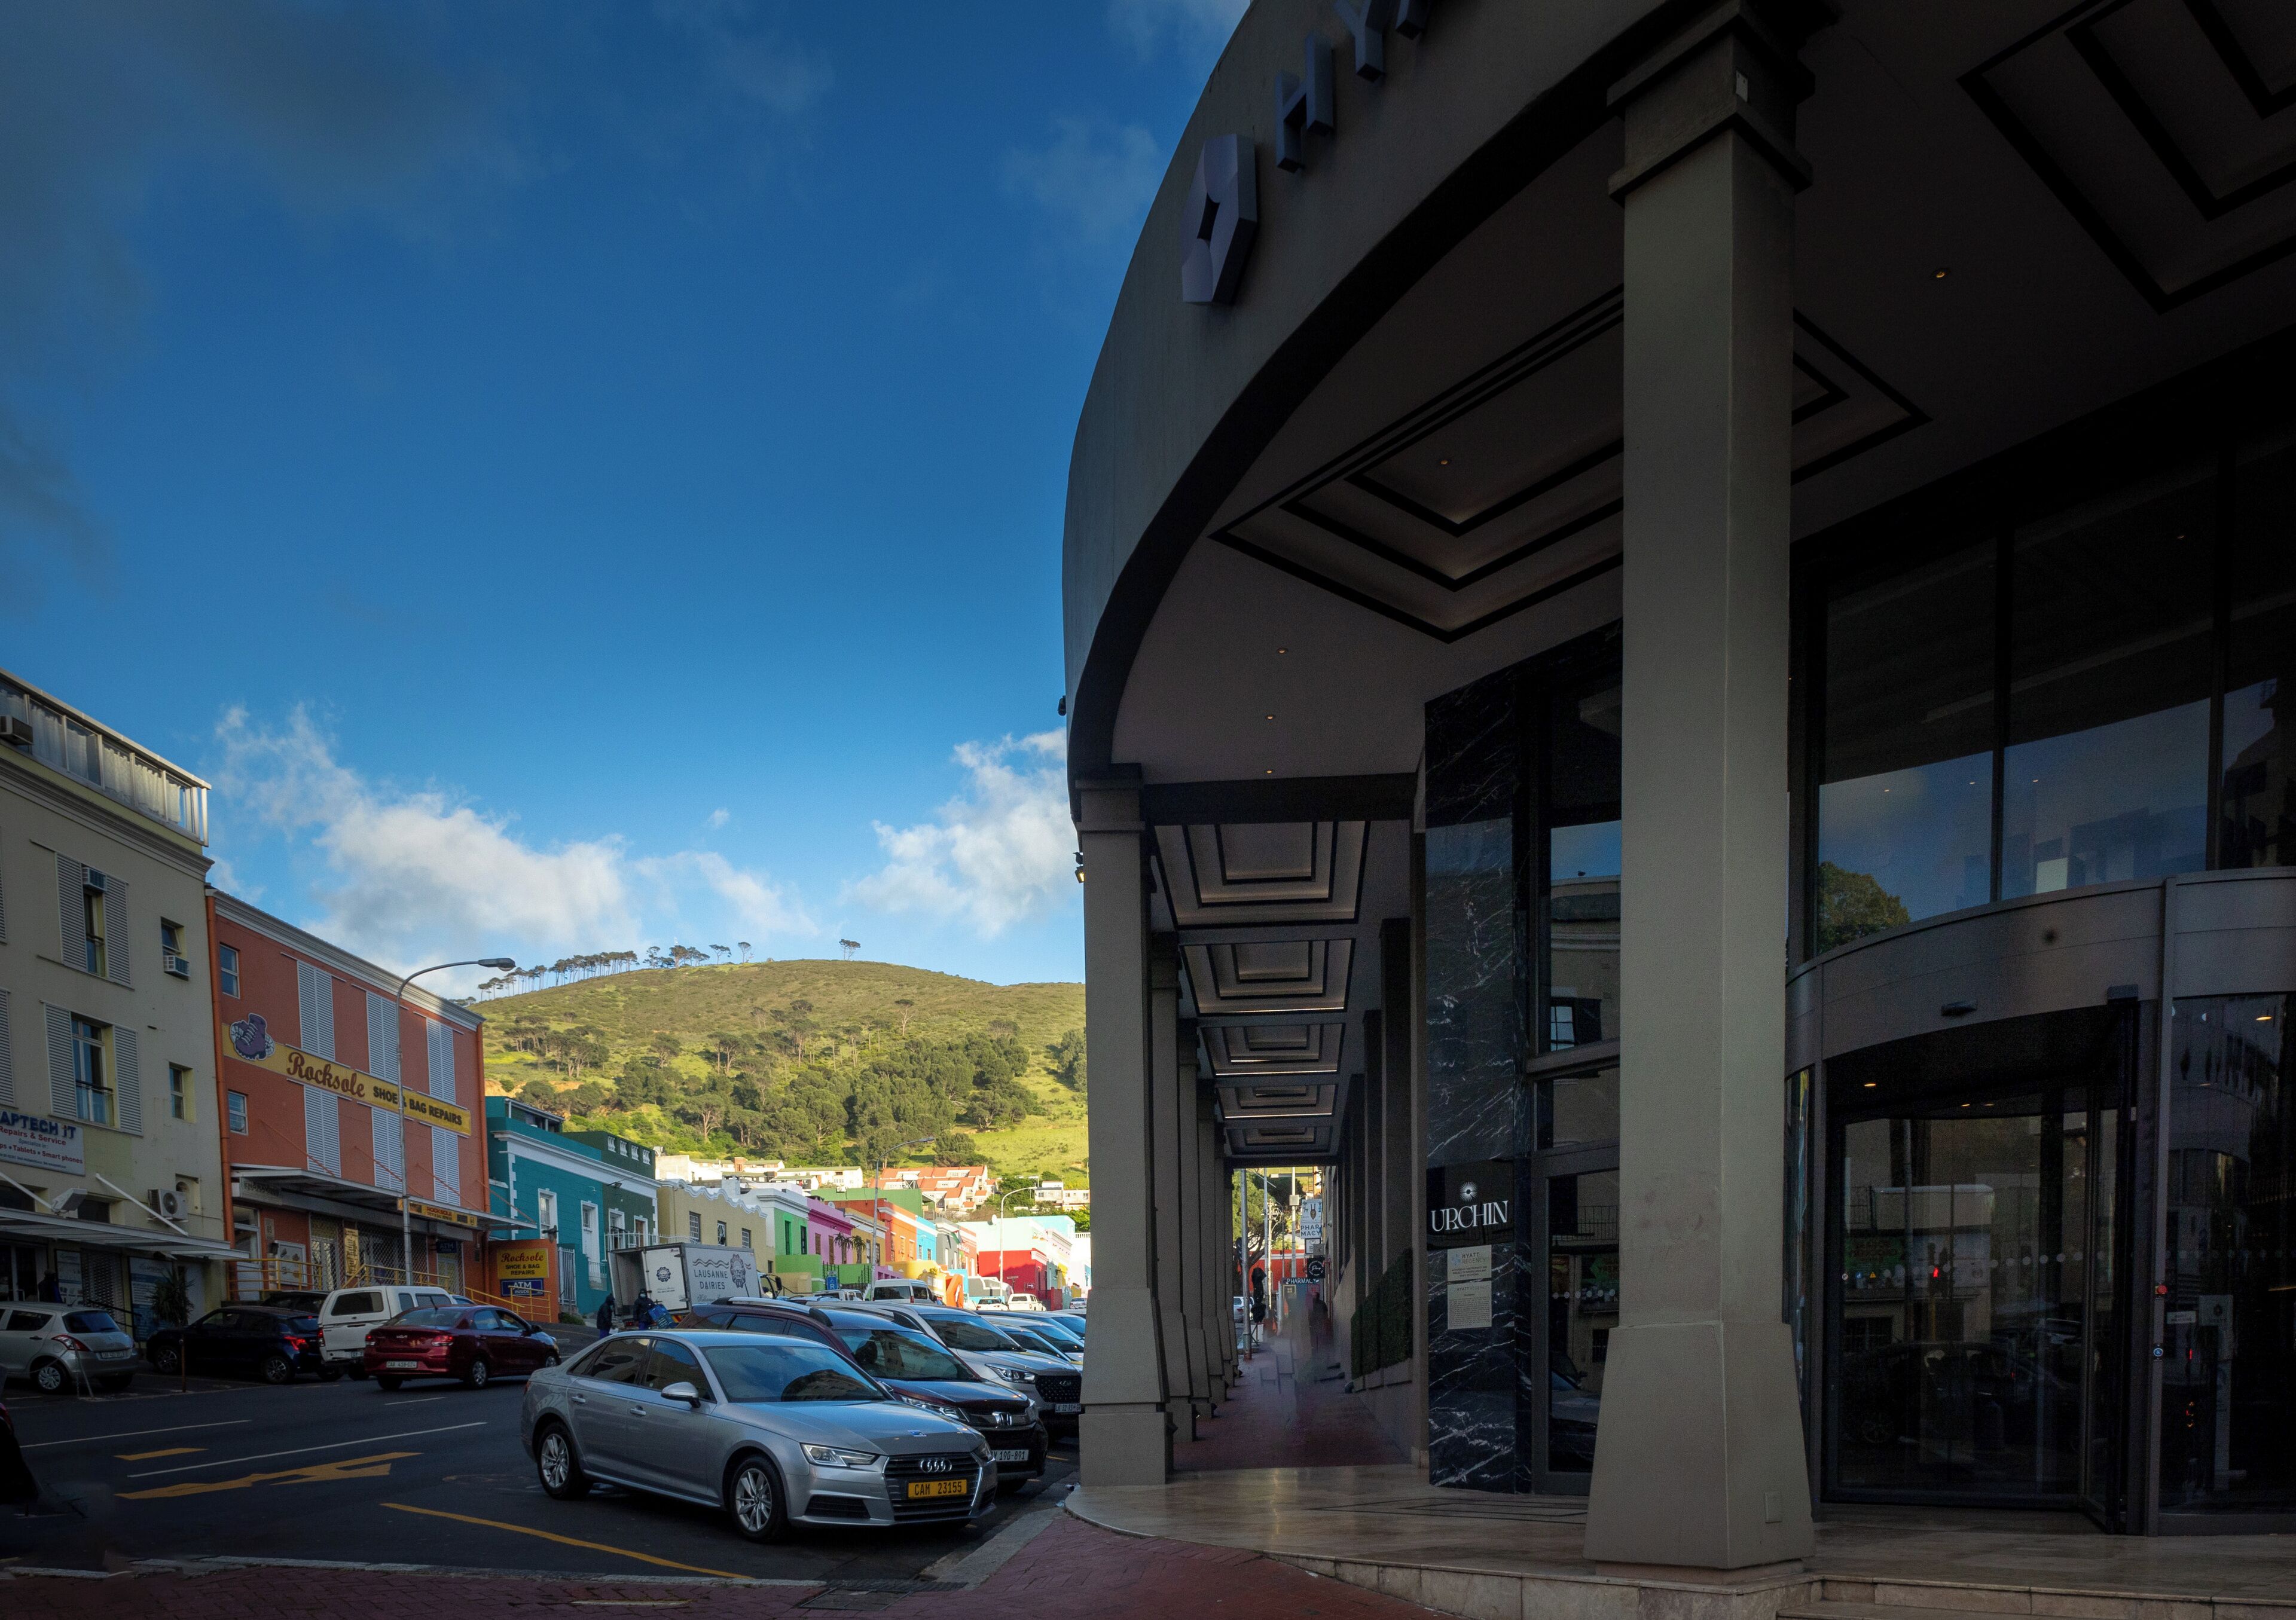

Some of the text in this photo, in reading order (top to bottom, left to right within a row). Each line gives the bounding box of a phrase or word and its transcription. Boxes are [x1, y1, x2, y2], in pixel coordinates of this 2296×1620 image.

[286, 1052, 365, 1098] Rocksole
[373, 1086, 398, 1105] SHOE
[409, 1098, 427, 1114] BAG
[429, 1106, 462, 1125] REPAIRS
[38, 1134, 66, 1145] Service
[13, 1145, 36, 1155] Tablets
[42, 1151, 61, 1160] Smart
[62, 1156, 83, 1164] phones
[1430, 1200, 1509, 1231] URCHIN
[501, 1252, 544, 1263] Rocksole
[694, 1269, 728, 1279] LAUSANNE
[513, 1281, 532, 1289] ATM
[700, 1281, 725, 1290] DAIRIES
[999, 1451, 1025, 1460] 190-891
[915, 1481, 962, 1495] CAM 23155
